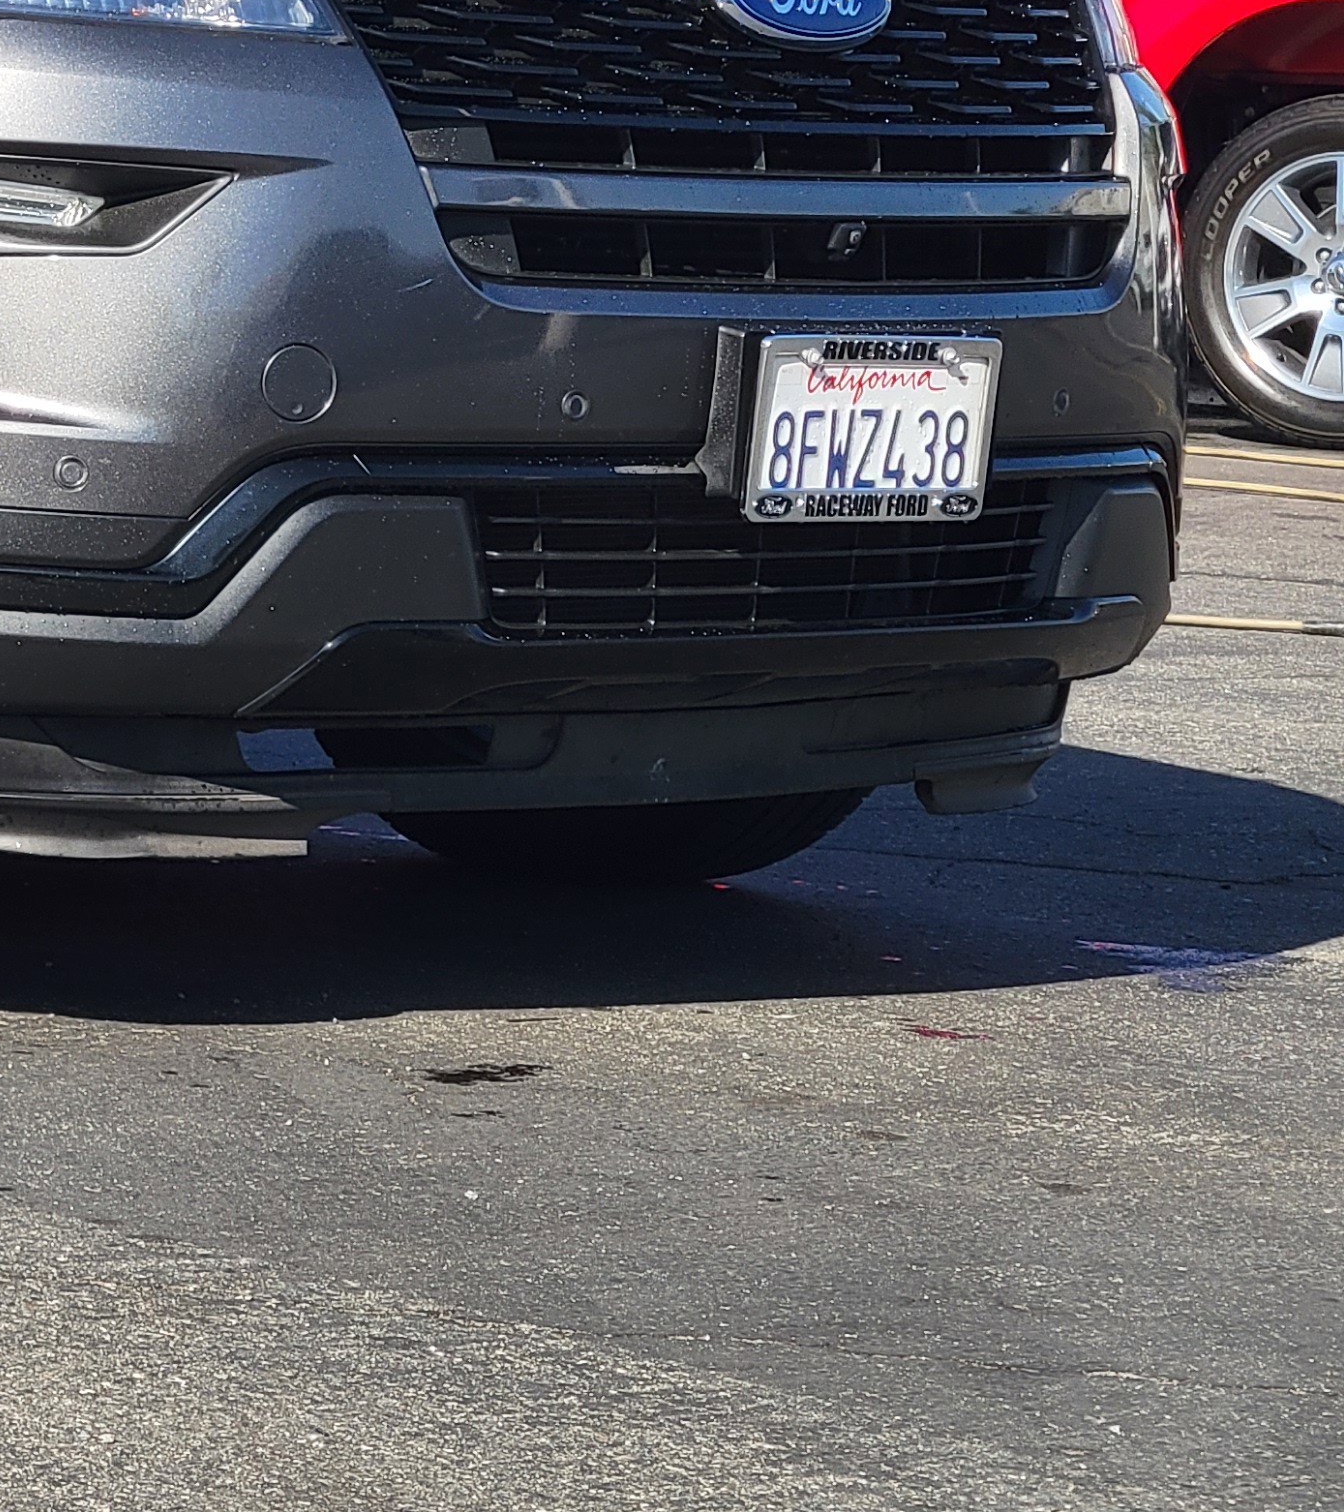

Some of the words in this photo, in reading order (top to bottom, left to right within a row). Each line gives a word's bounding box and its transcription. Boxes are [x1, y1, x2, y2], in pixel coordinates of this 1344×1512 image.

[822, 341, 941, 361] RIVERSIDE
[807, 364, 947, 405] California
[768, 408, 970, 489] 8FWZ438
[804, 494, 883, 518] RACEWAY
[886, 494, 929, 518] FORD
